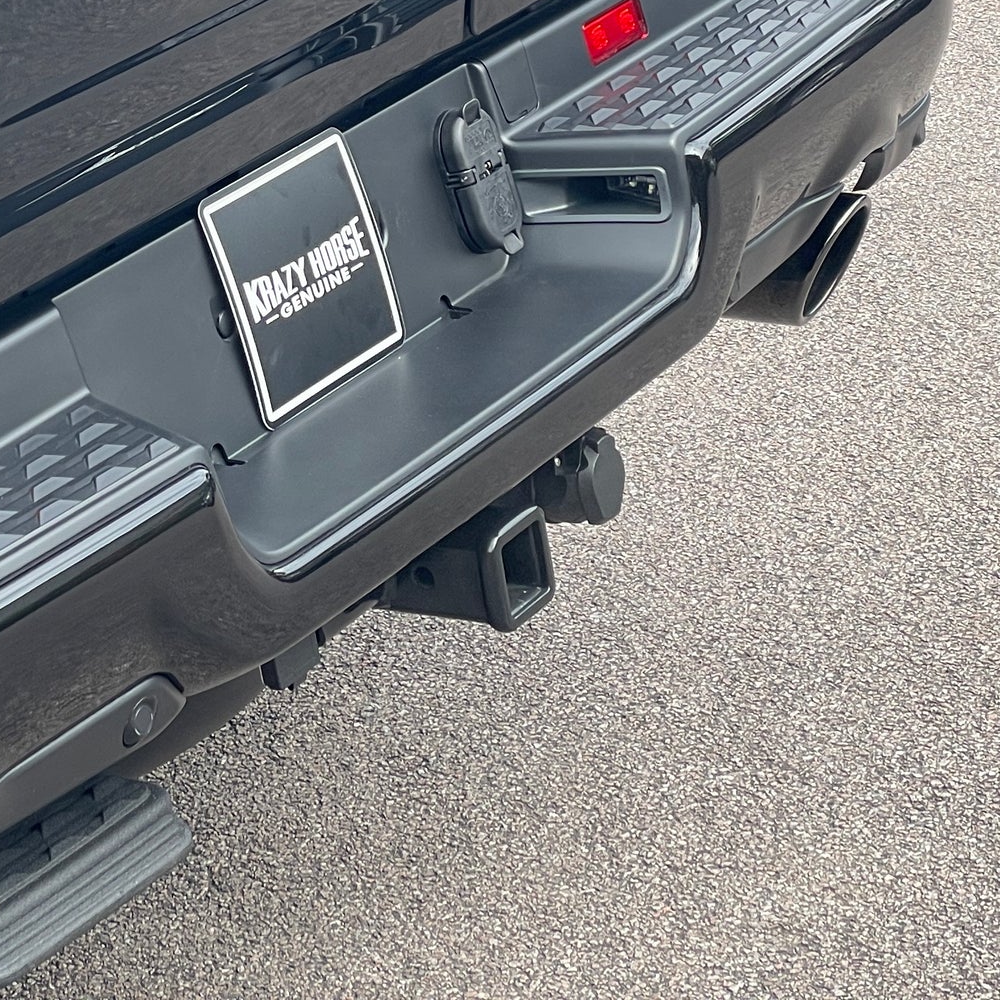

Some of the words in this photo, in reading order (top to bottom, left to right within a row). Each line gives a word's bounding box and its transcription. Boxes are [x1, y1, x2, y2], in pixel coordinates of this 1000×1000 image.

[243, 257, 308, 324] KRAZY
[307, 215, 370, 278] HORSE
[280, 266, 352, 318] GENUINE
